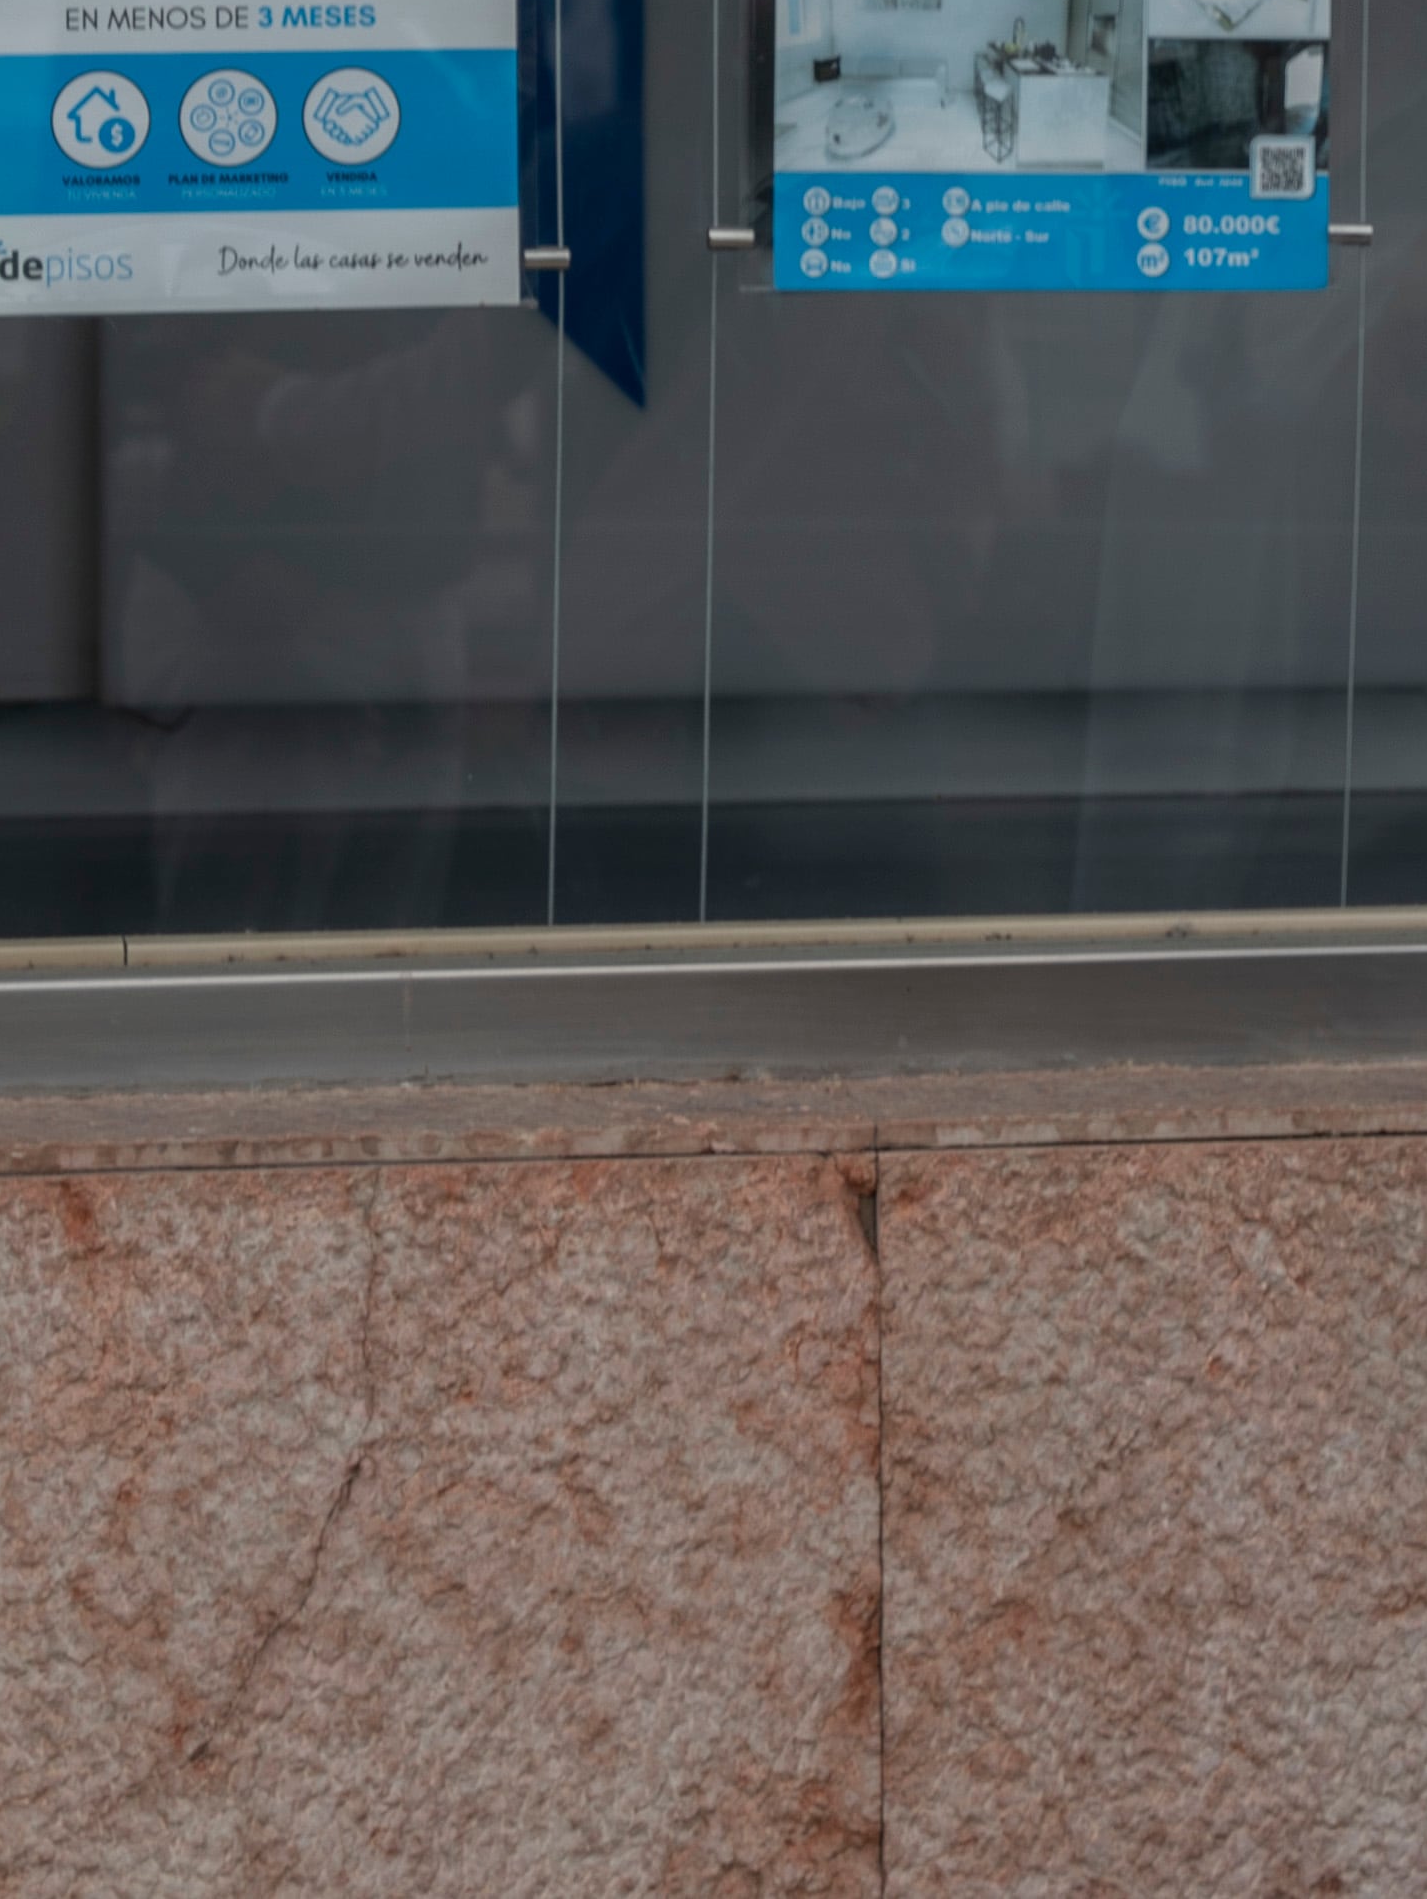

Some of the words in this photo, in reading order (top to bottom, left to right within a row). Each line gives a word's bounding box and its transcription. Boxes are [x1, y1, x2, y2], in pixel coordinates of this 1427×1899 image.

[66, 7, 100, 31] EN
[108, 6, 206, 31] MENOS
[215, 5, 249, 28] DE
[258, 6, 273, 27] 3
[281, 4, 376, 27] MESES
[62, 175, 140, 186] VALORAMOS
[169, 173, 199, 185] PLAN
[202, 173, 216, 184] DE
[218, 171, 288, 184] MARKETING
[326, 171, 377, 182] VENDIDA
[1183, 215, 1280, 235] 80.000€
[217, 245, 288, 275] Donde
[293, 245, 320, 271] las
[327, 253, 382, 271] casas
[386, 254, 409, 269] se
[413, 243, 487, 269] venden
[1184, 248, 1259, 268] 107m²
